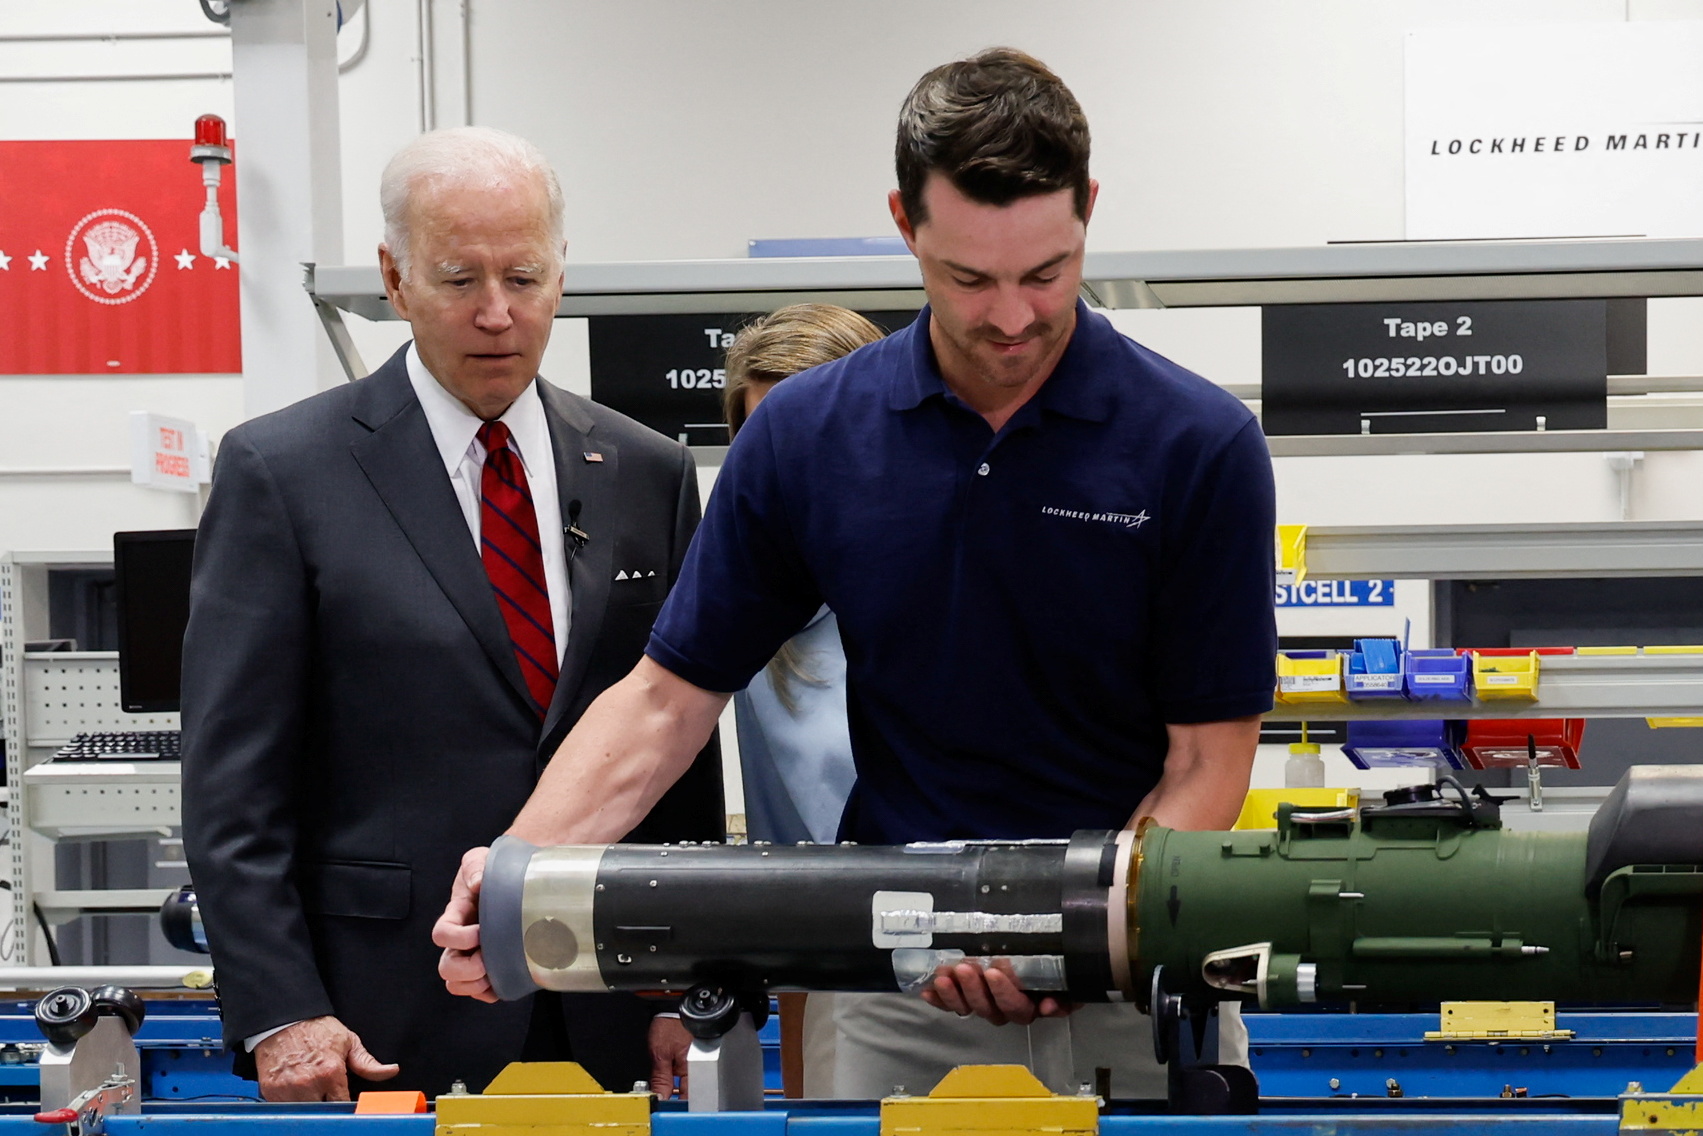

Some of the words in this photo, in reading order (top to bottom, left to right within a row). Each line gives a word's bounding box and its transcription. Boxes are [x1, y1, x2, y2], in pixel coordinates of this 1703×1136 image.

[1431, 136, 1590, 155] LOCKHEED
[1383, 317, 1449, 342] Tape
[1456, 315, 1472, 336] 2
[1041, 506, 1090, 522] LOCKHEED
[1092, 513, 1130, 524] MARTIN
[1368, 579, 1384, 603] 2
